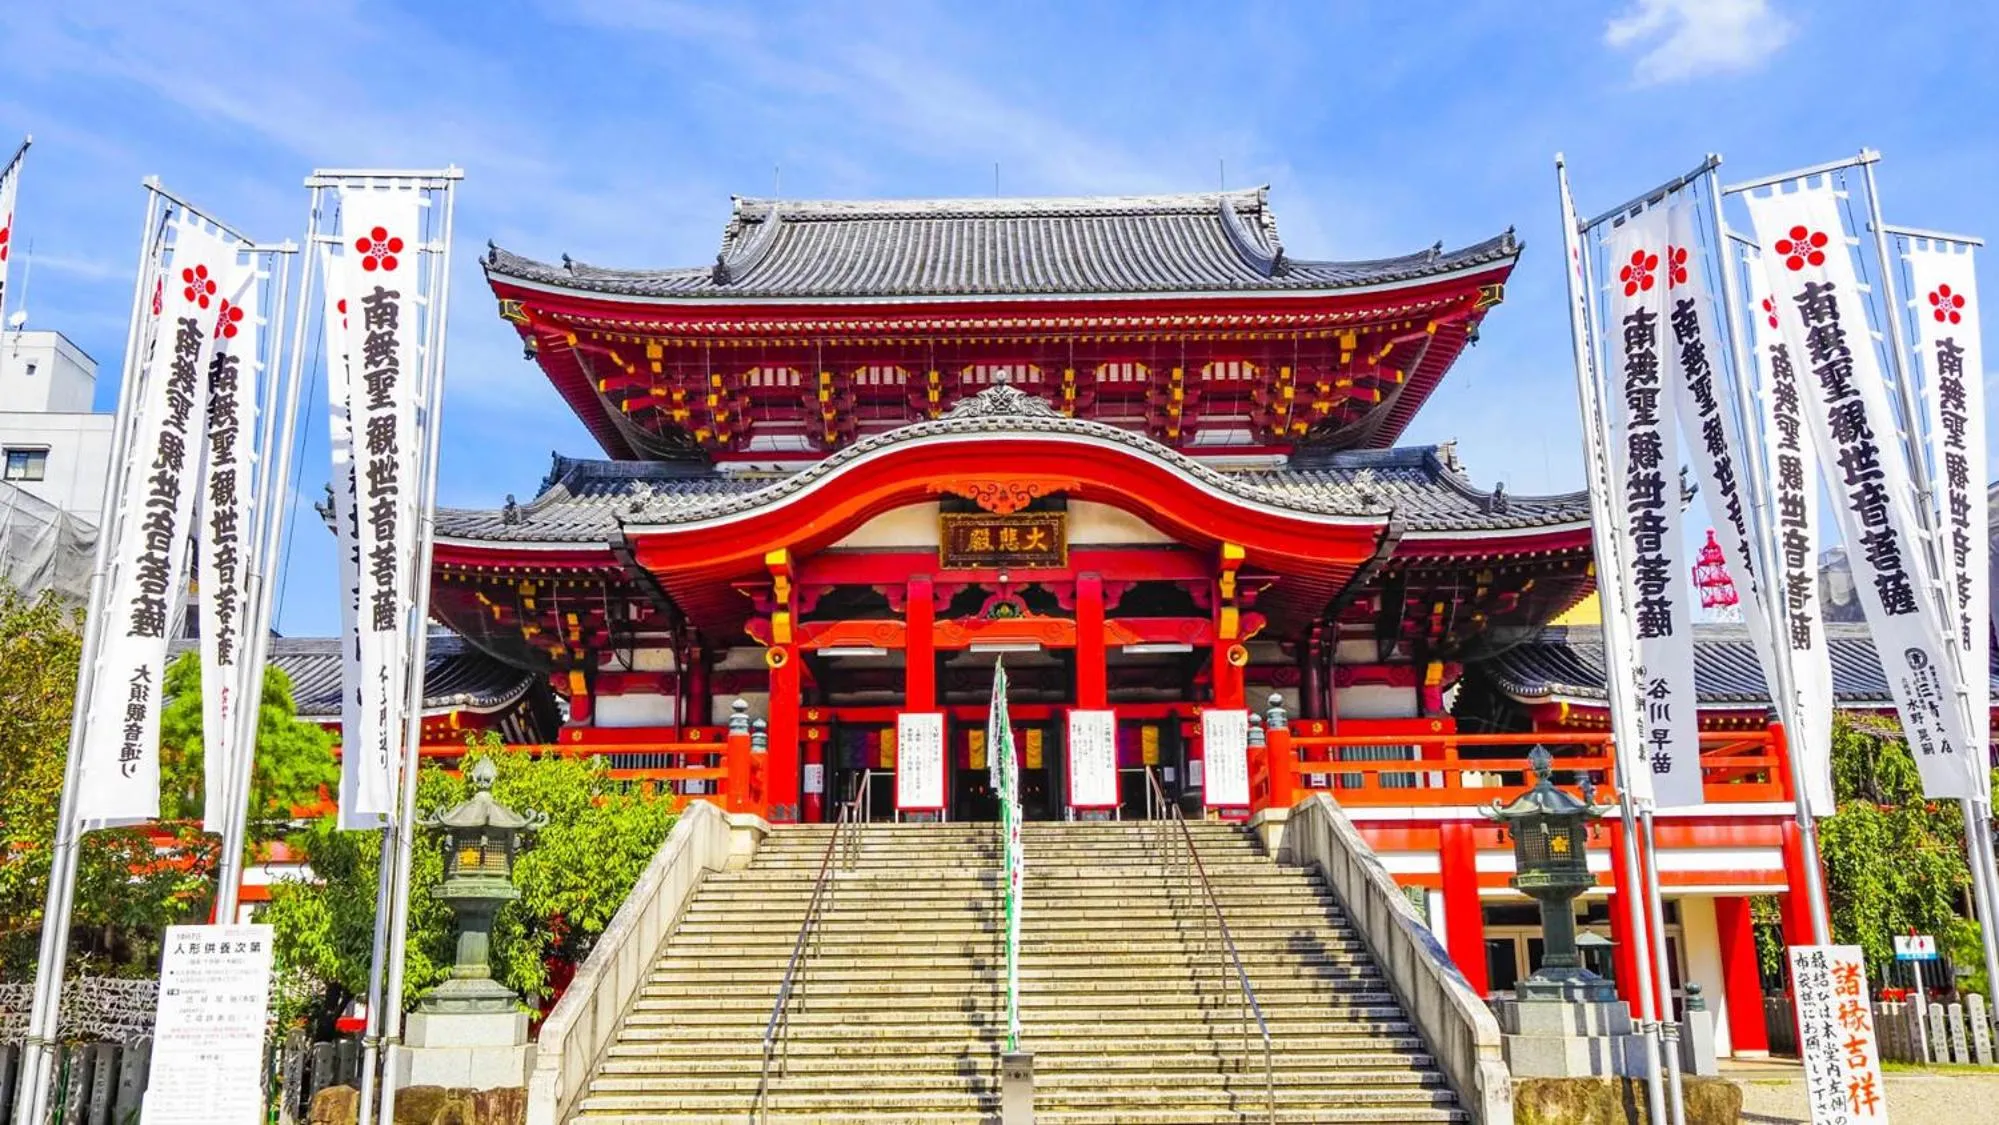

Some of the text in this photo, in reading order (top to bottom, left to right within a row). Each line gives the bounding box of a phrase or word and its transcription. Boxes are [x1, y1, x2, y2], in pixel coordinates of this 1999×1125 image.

[361, 286, 401, 632] 南無聖観世音菩薩
[1793, 281, 1919, 616] 南無聖観世音菩薩
[1831, 960, 1880, 1116] 諸縁吉祥
